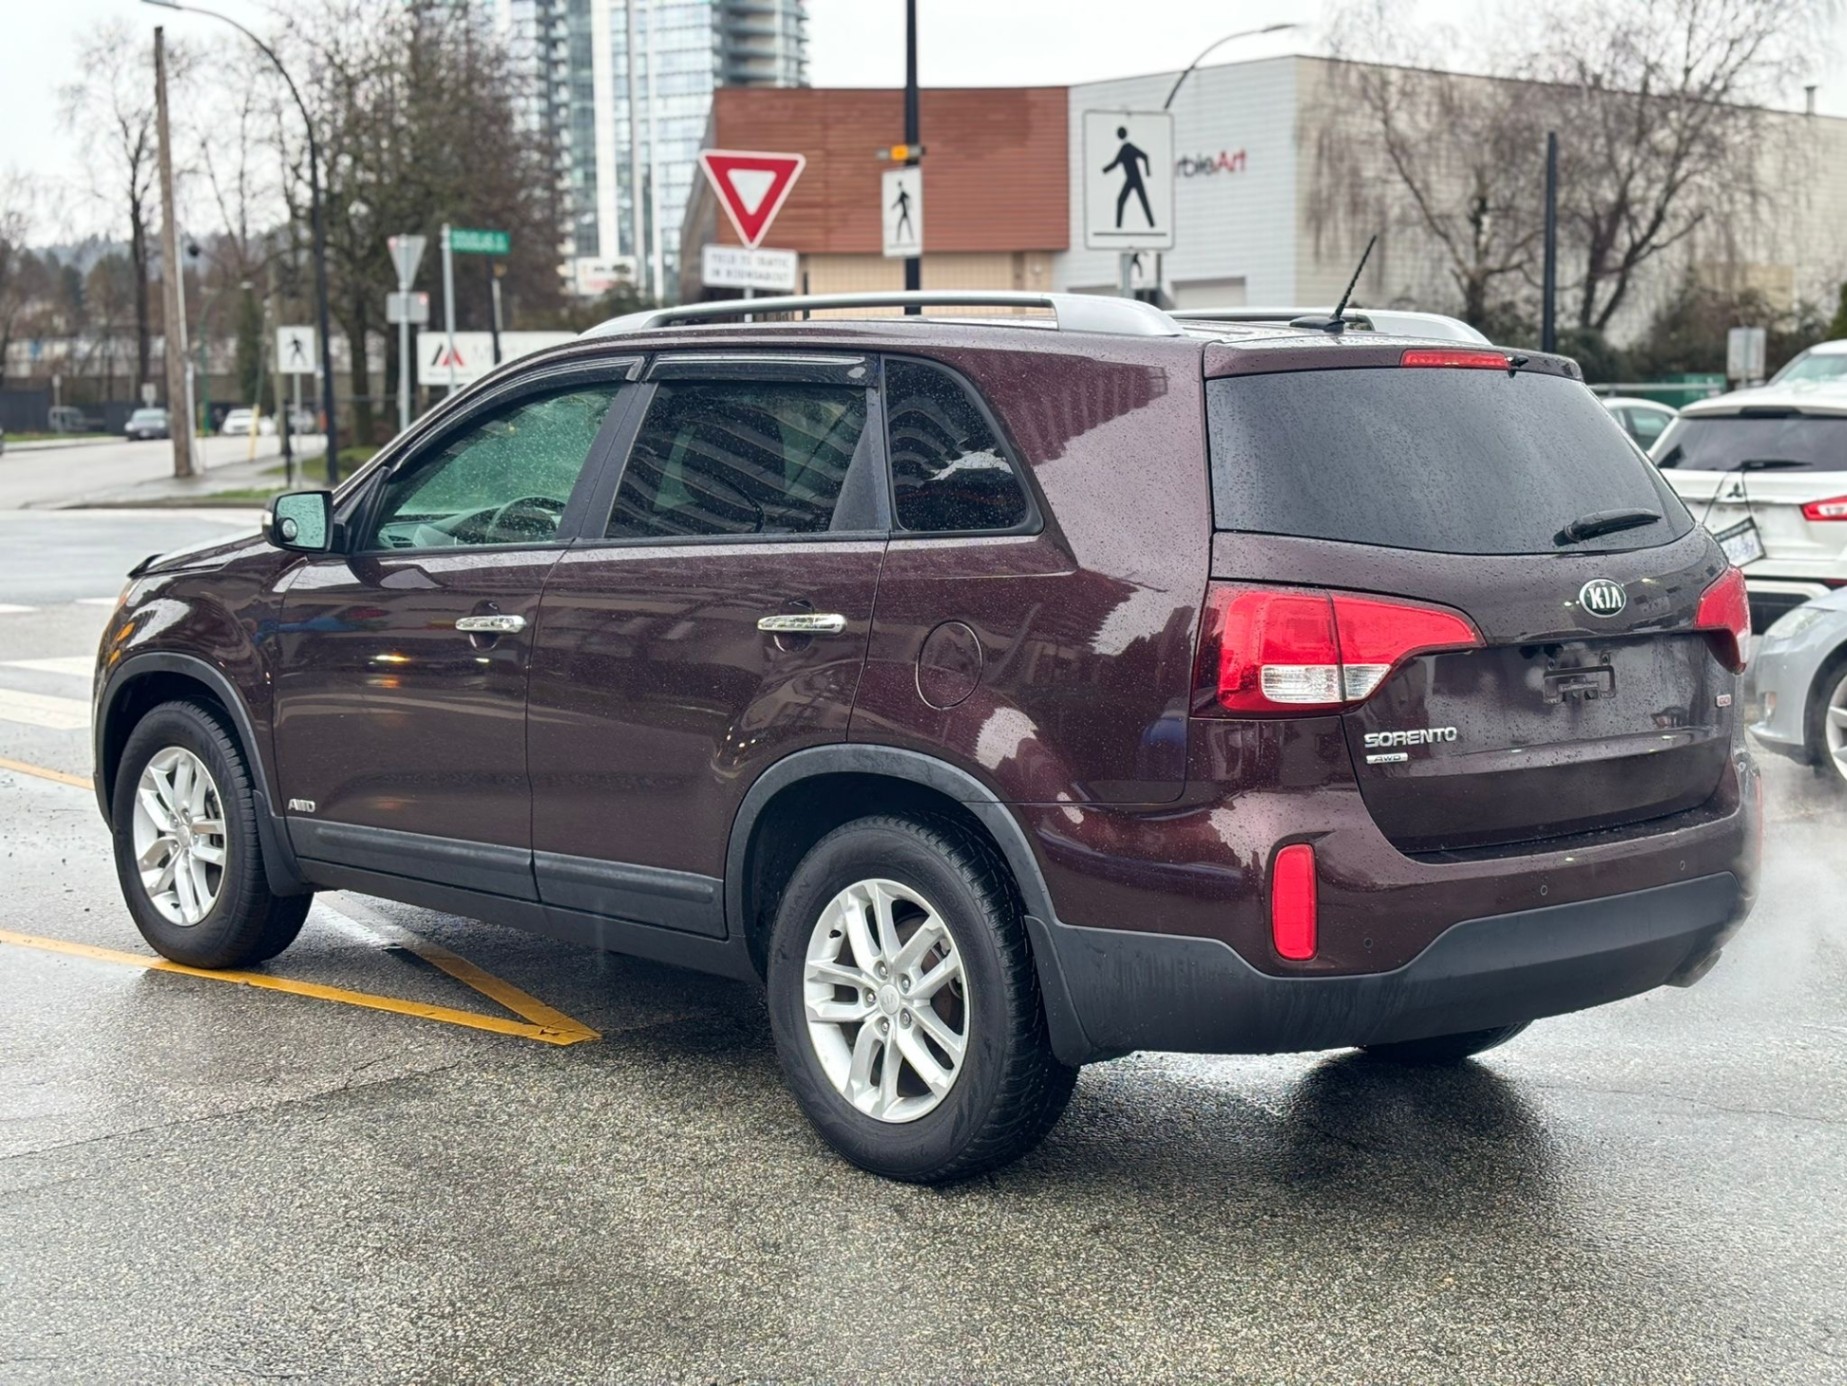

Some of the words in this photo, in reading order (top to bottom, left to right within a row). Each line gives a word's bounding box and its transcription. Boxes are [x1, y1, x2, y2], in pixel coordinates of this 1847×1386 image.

[1588, 586, 1622, 609] KIA
[1364, 727, 1457, 748] SORENTO
[1373, 754, 1402, 763] AWD
